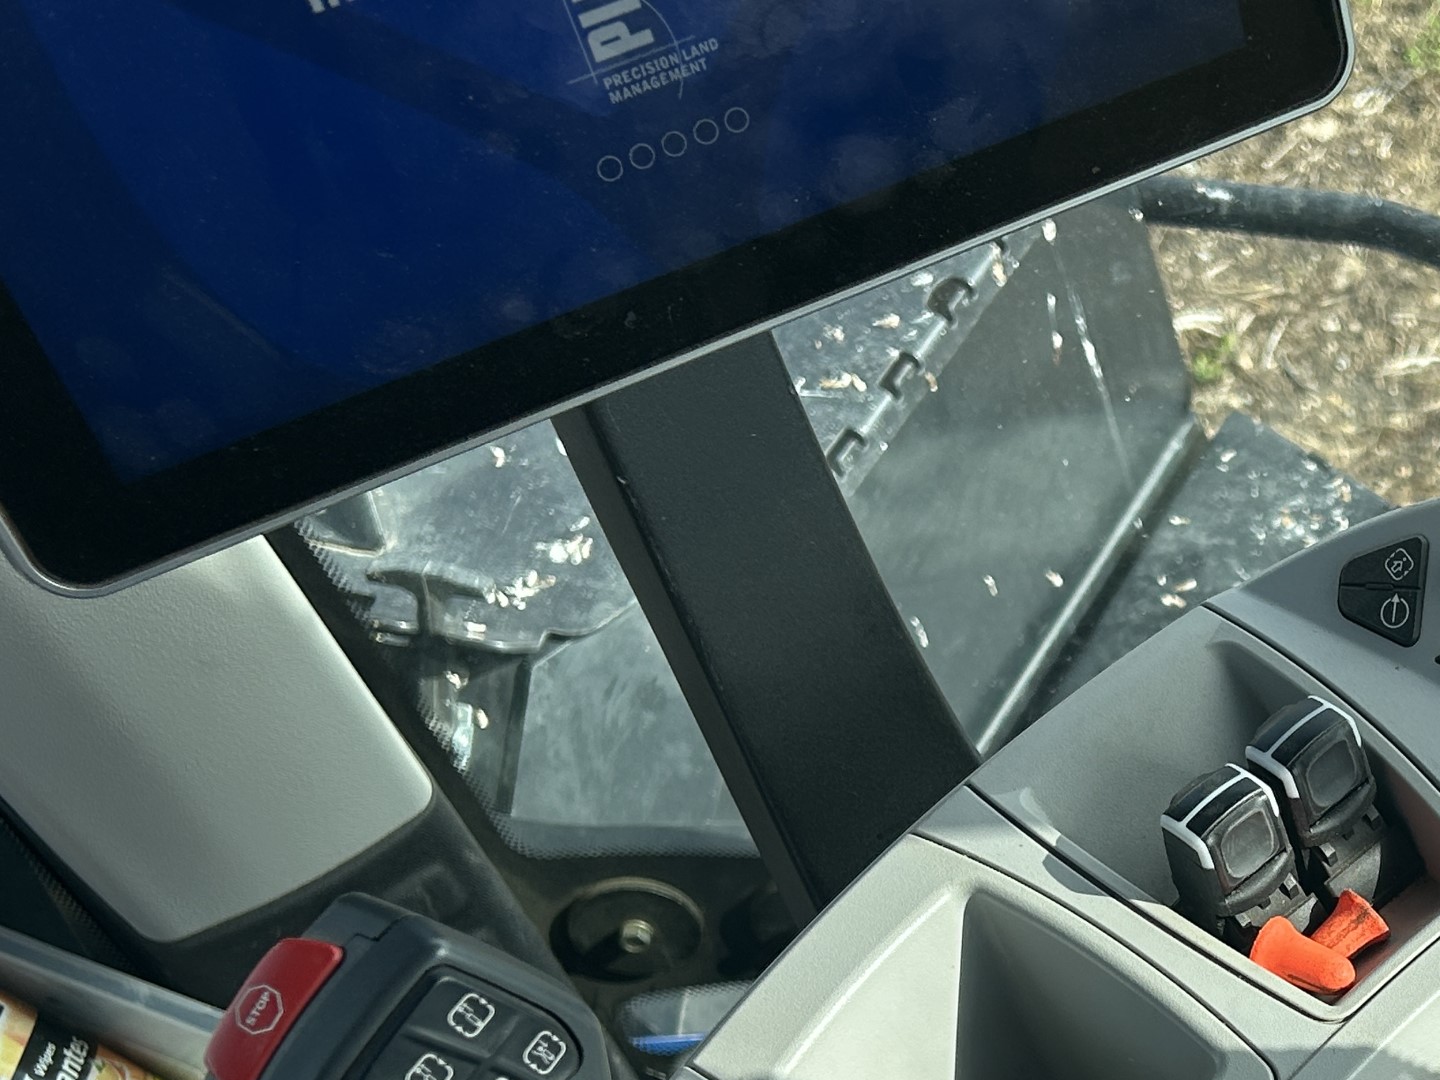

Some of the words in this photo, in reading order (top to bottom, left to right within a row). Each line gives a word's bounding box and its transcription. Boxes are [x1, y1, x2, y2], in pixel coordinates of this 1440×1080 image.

[602, 52, 680, 90] PRECISION
[682, 37, 719, 61] LAND
[607, 57, 708, 104] MANAGEMENT
[245, 991, 270, 1026] STOP
